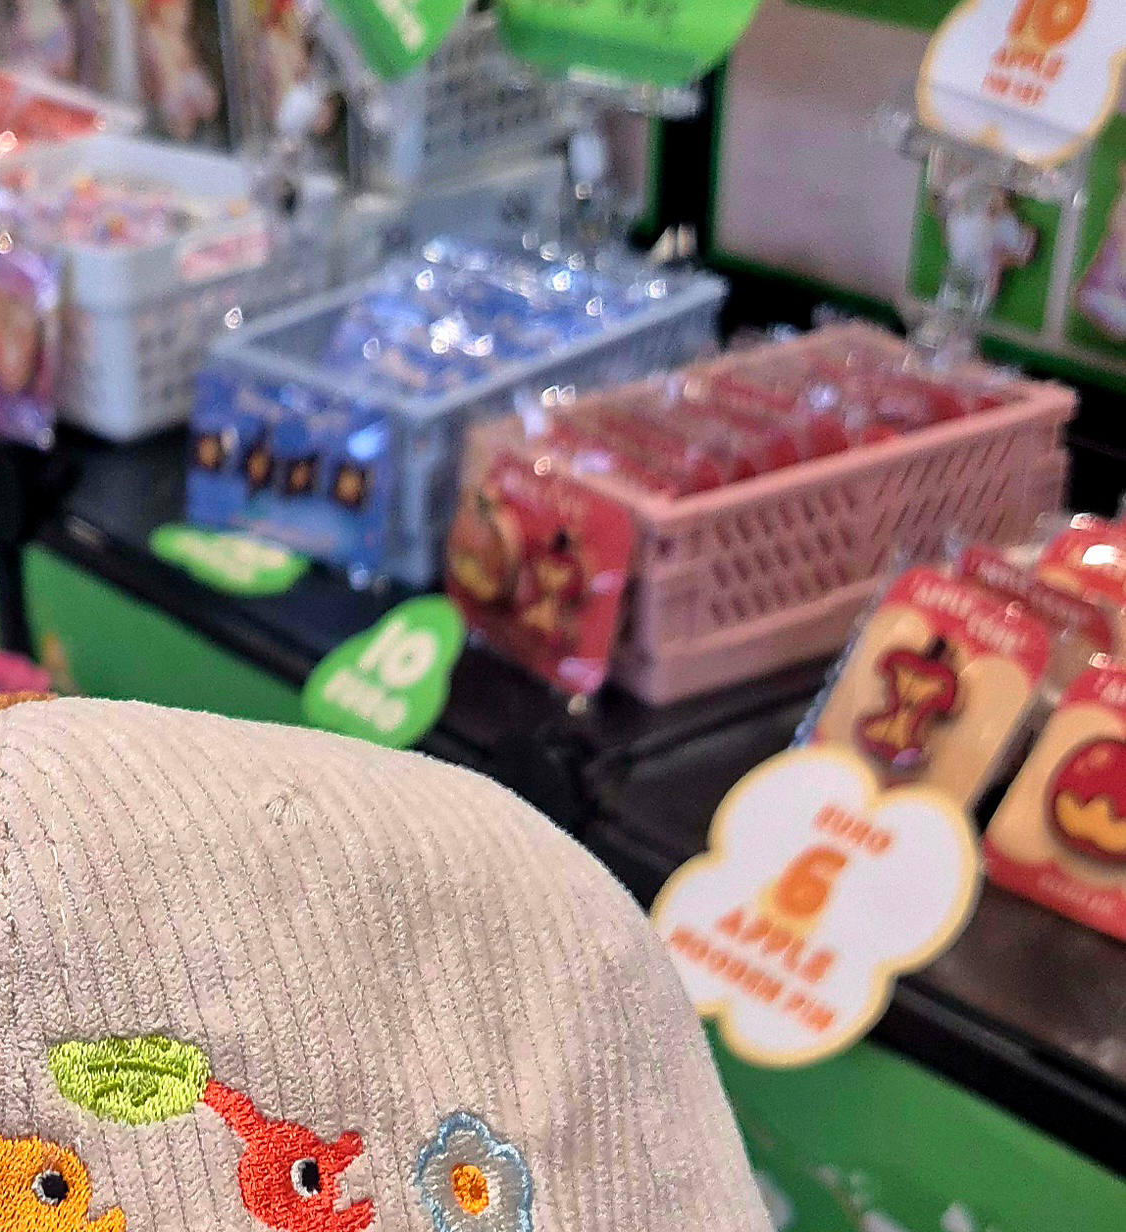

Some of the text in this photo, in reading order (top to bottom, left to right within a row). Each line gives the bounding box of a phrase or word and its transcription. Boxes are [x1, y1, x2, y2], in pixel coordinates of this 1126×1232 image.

[358, 619, 436, 688] 10
[814, 806, 893, 856] EURO
[776, 847, 846, 919] 6
[670, 926, 835, 1033] WOODEN PIN
[716, 908, 835, 983] APPLE
